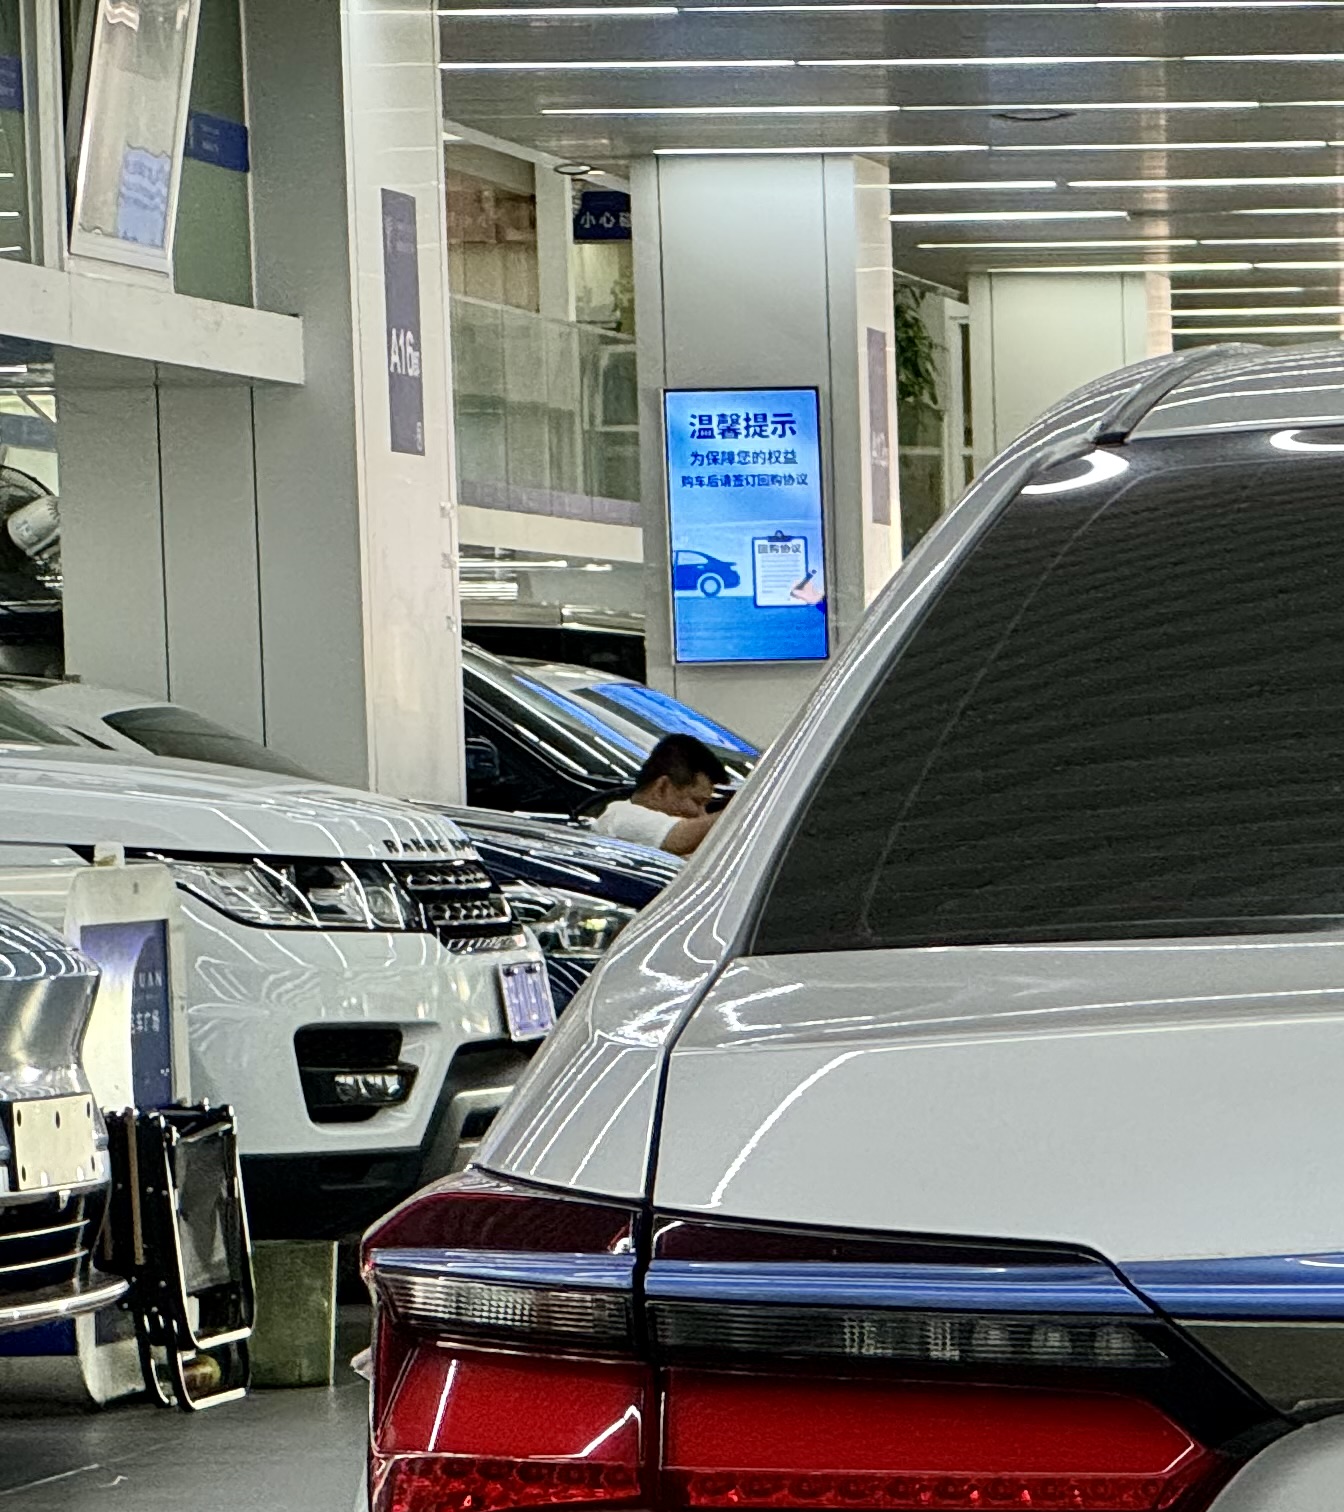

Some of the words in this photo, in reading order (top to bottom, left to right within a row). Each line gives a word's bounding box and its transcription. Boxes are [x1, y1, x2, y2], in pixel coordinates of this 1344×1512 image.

[689, 412, 797, 440] 温馨提示
[690, 449, 799, 467] 为保障您的权益
[681, 473, 808, 489] 购车后请签订回购协议
